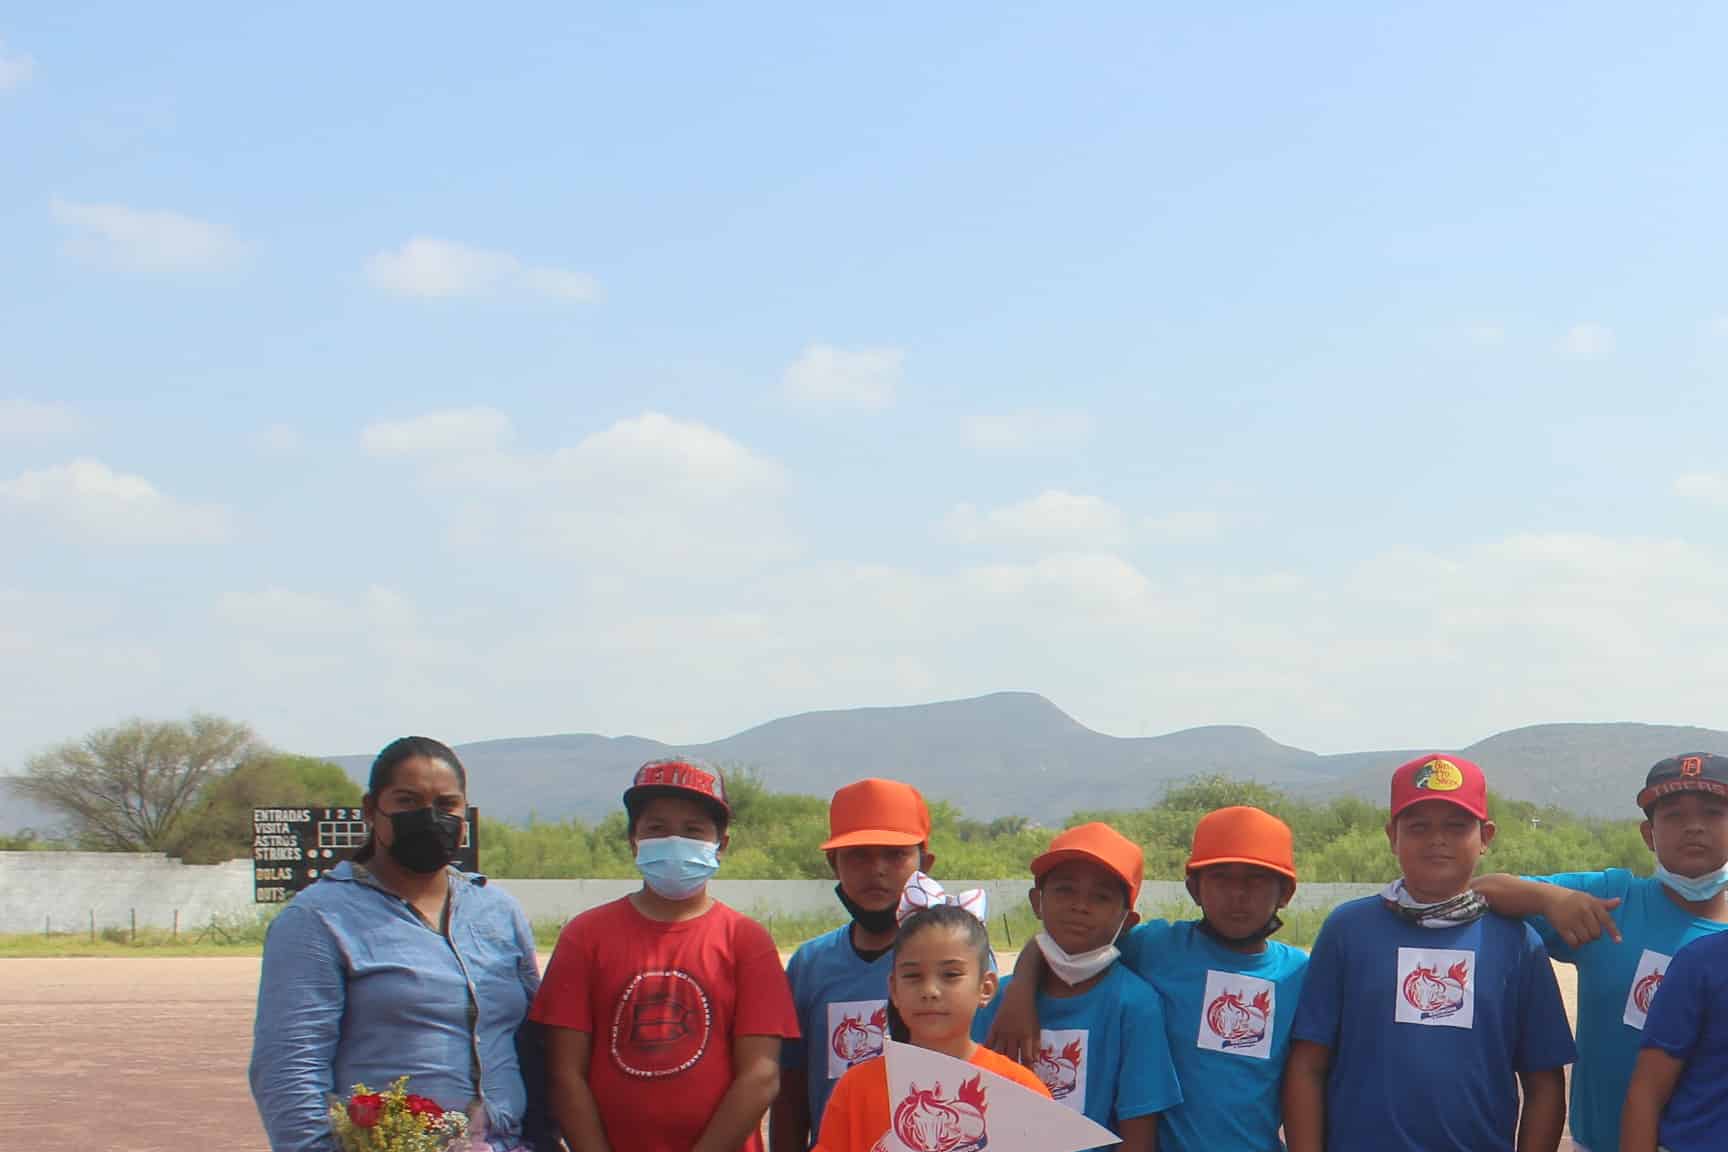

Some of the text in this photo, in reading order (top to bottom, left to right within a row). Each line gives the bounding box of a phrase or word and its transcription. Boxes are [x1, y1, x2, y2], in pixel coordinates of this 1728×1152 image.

[254, 809, 311, 822] ENTRADAS
[324, 810, 332, 819] 1
[336, 809, 347, 819] 2
[254, 823, 290, 833] VISITA
[254, 835, 297, 847] ASTROS
[254, 848, 302, 860] STRIKES
